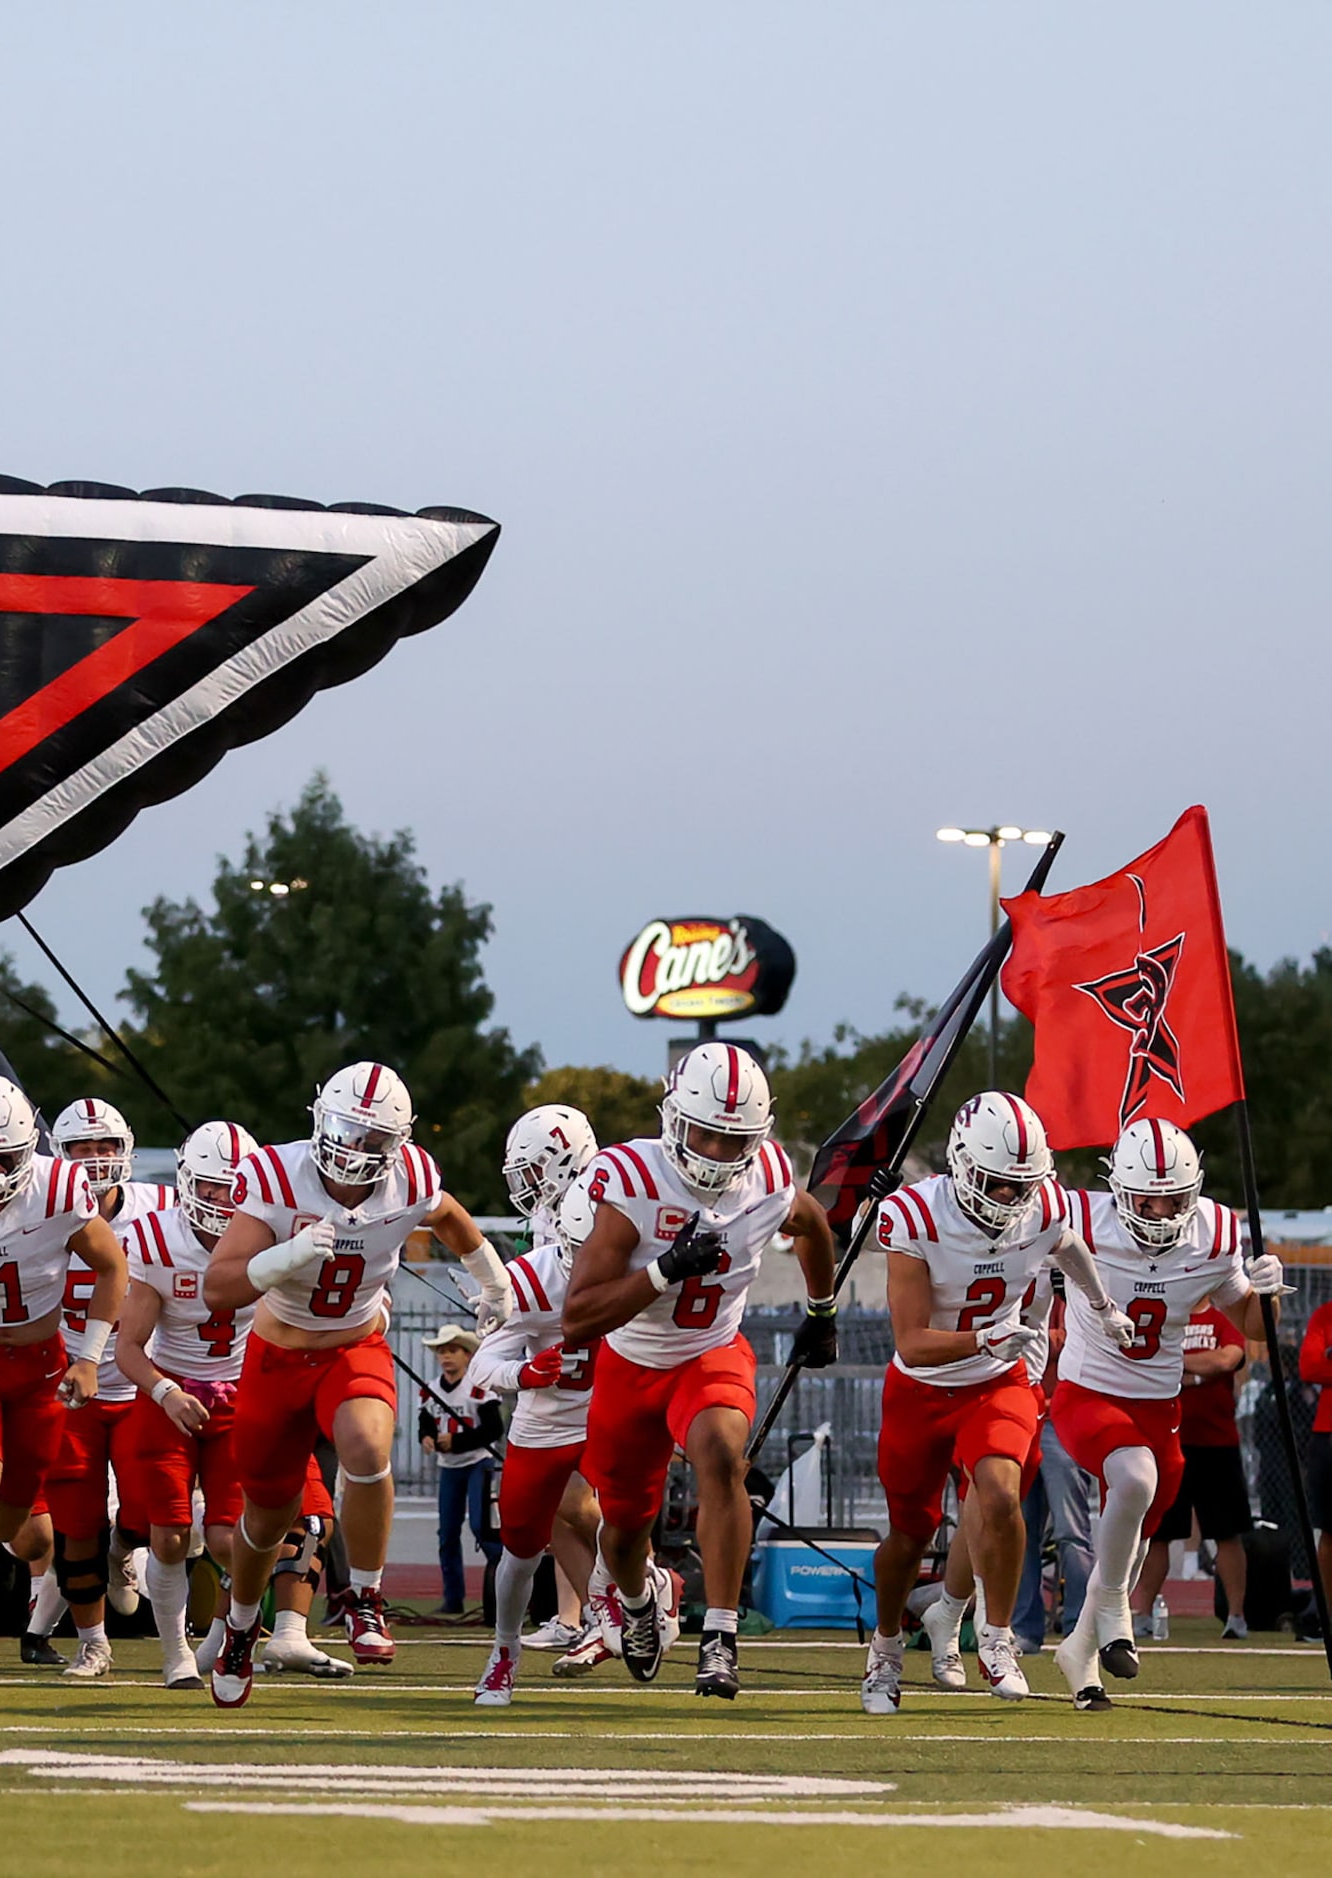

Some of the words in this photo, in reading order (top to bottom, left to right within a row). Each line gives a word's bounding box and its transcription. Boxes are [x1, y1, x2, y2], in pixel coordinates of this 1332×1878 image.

[623, 919, 756, 1018] Cane's
[550, 1126, 571, 1150] 7
[588, 1168, 610, 1204] 6
[877, 1211, 894, 1248] 2
[309, 1254, 366, 1318] 8
[973, 1262, 1005, 1274] COPPELL
[957, 1277, 997, 1332] 2
[1133, 1282, 1167, 1294] COPPELL
